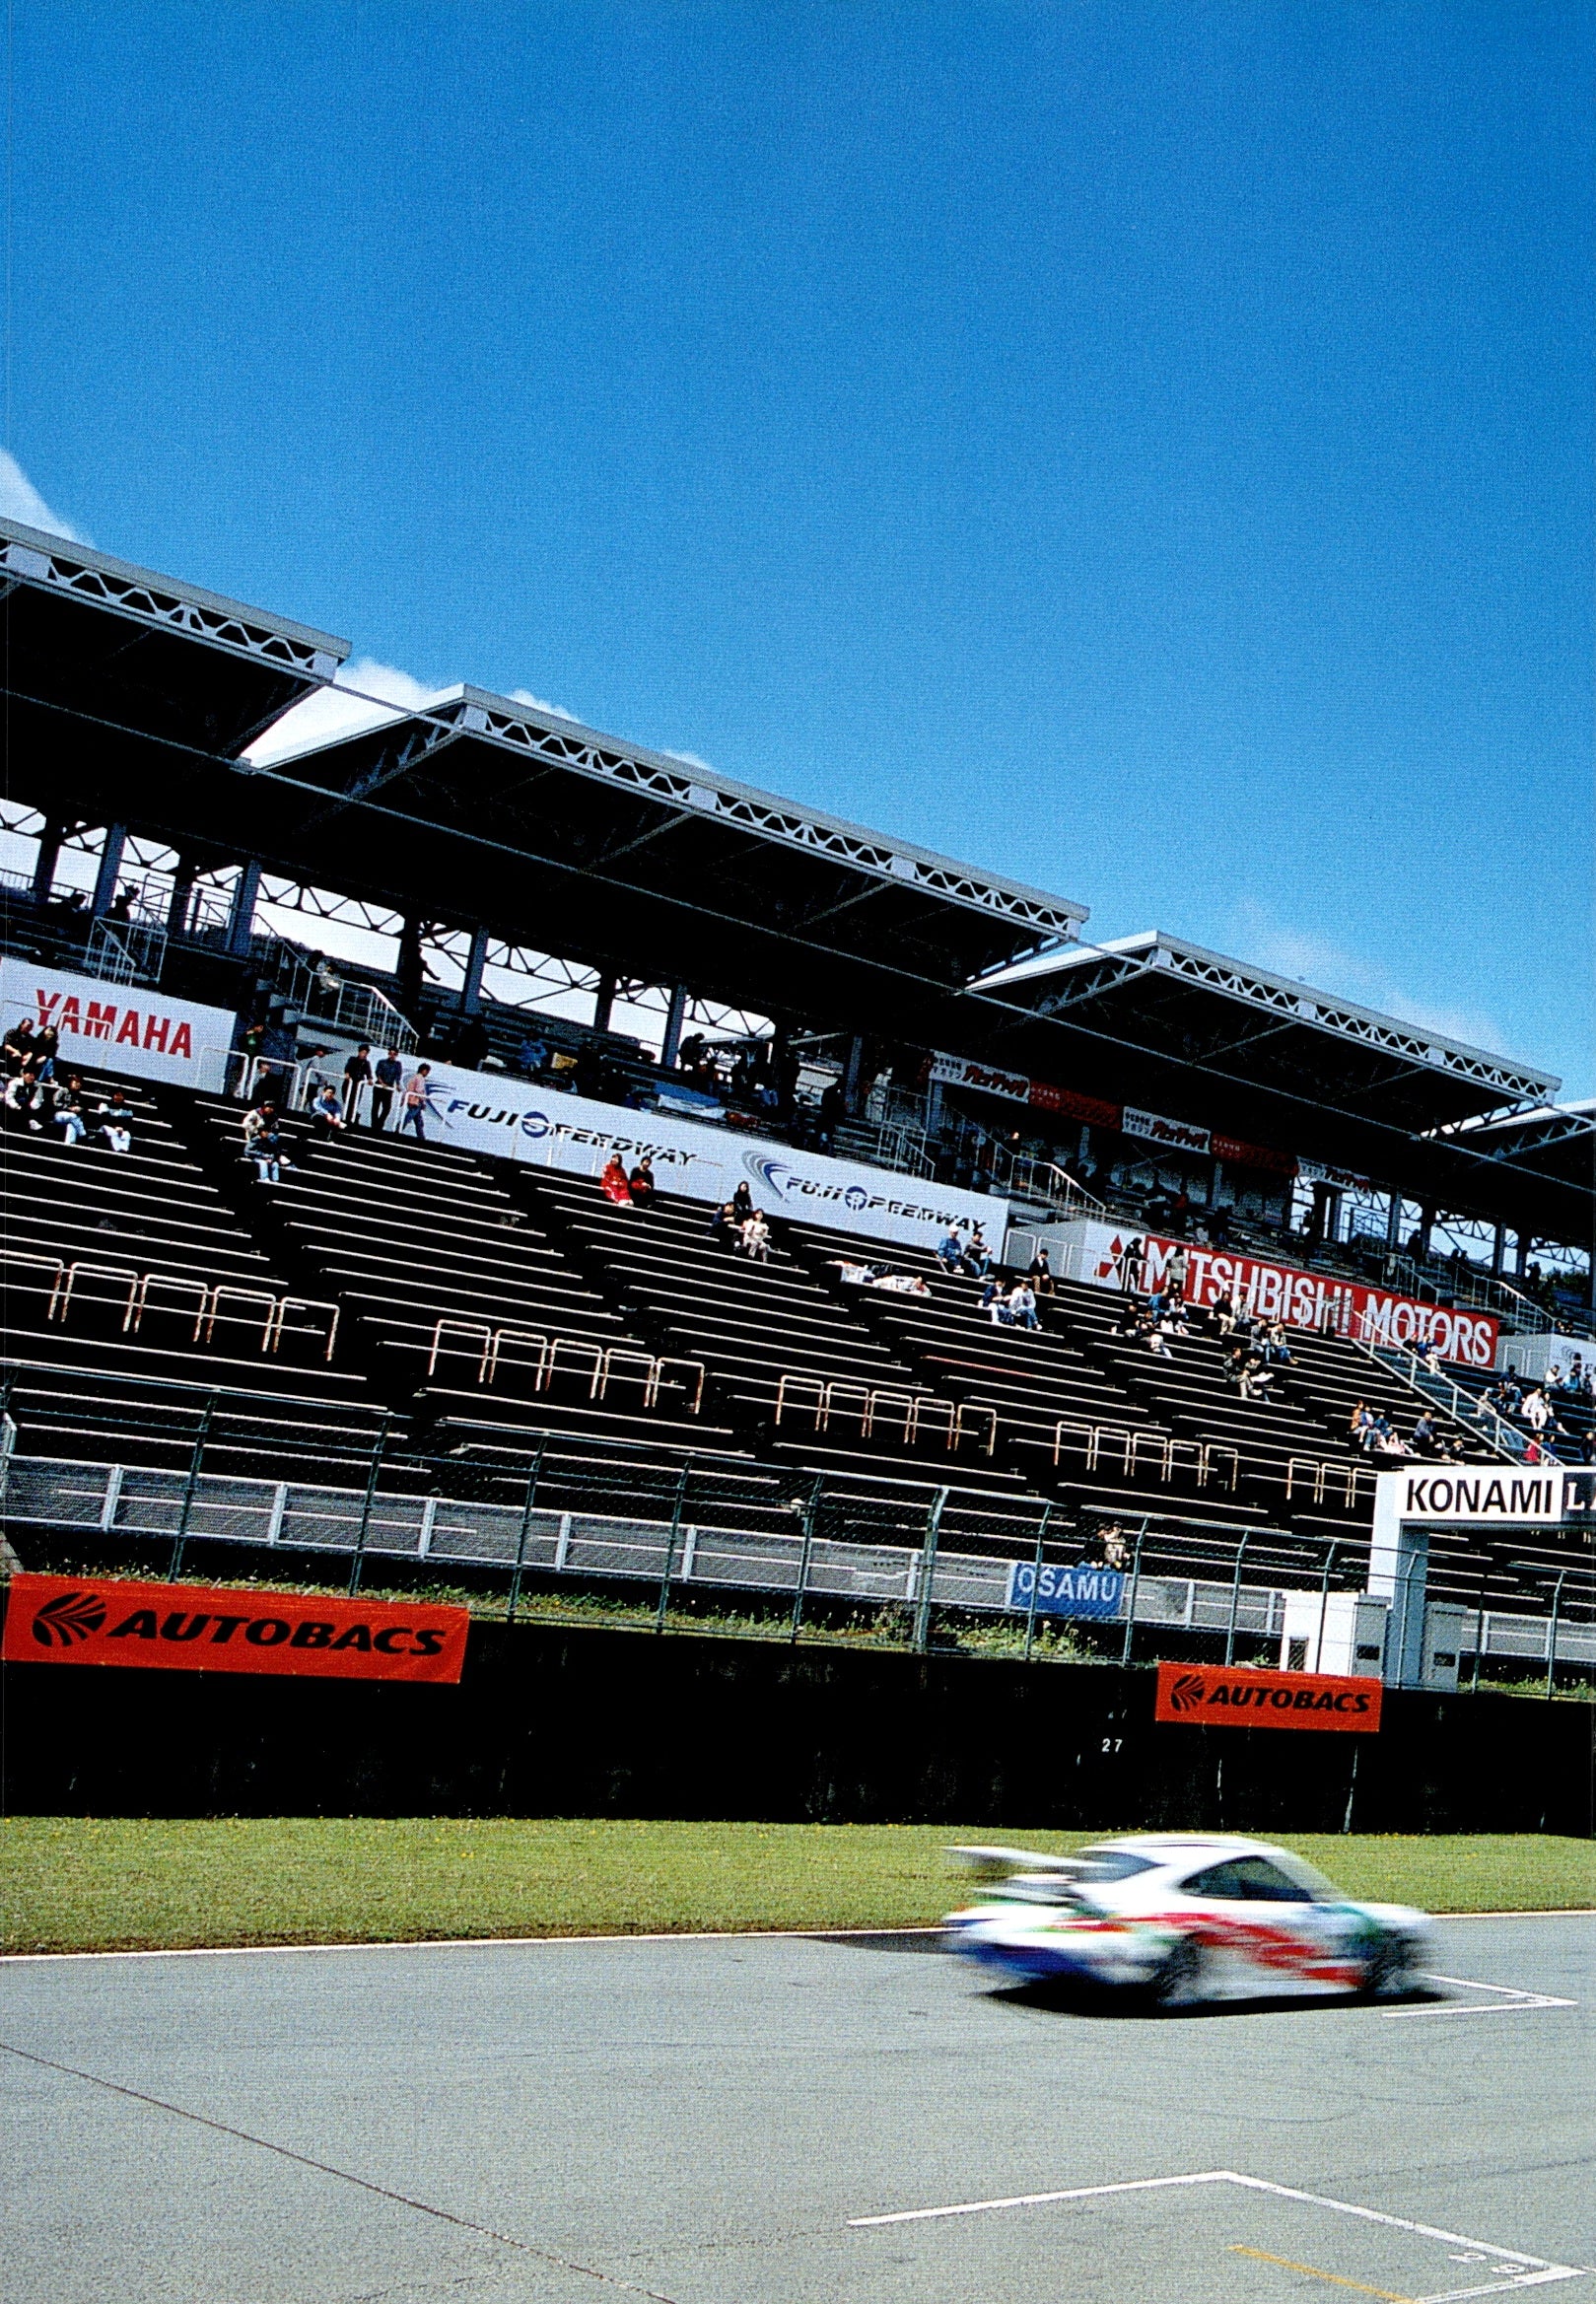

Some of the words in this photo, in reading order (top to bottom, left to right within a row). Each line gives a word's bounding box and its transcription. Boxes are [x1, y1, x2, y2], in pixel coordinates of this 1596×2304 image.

[36, 989, 191, 1059] YAMAHA
[448, 1099, 519, 1127] FUJI
[786, 1176, 843, 1200] FUJI
[1363, 1293, 1492, 1364] MOTORS
[1406, 1479, 1553, 1514] KONAMI
[1566, 1481, 1596, 1510] L
[1017, 1567, 1117, 1602] OSAMU
[105, 1610, 447, 1656] AUTOBACS
[1207, 1683, 1370, 1713] AUTOBACS
[1101, 1737, 1124, 1754] 27
